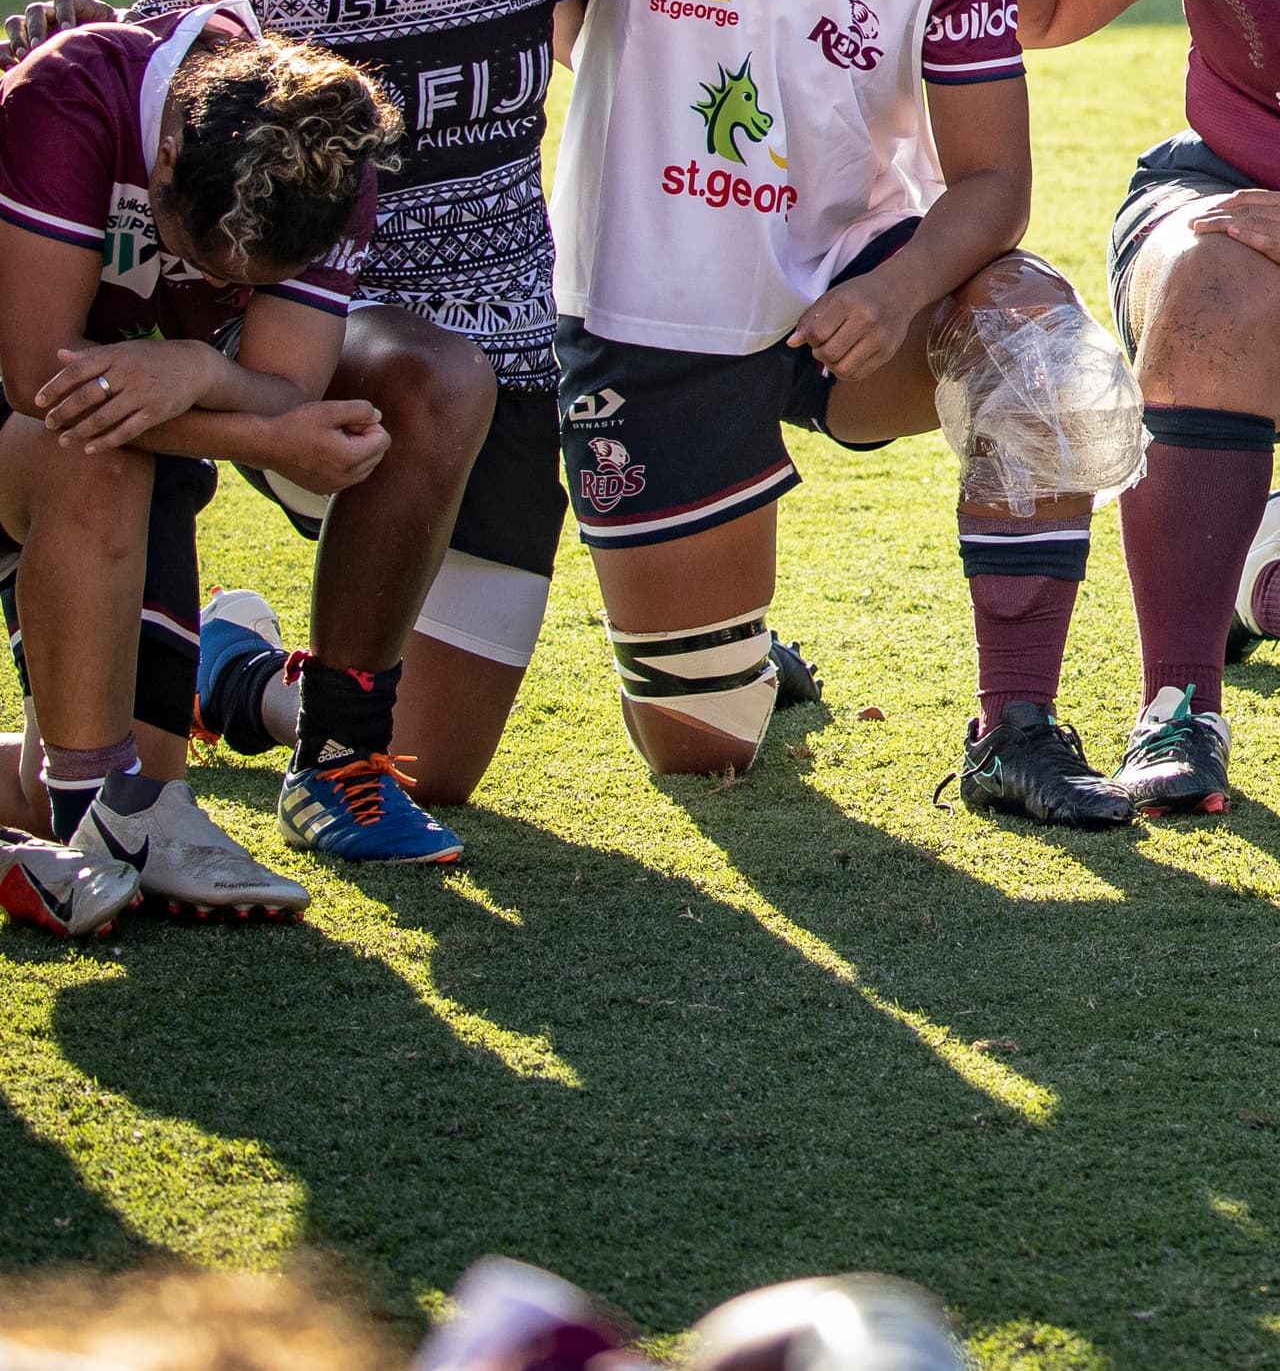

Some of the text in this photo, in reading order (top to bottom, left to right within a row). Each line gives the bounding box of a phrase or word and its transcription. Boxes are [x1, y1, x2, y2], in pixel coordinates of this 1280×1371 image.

[807, 16, 884, 72] REDS
[416, 41, 549, 131] FIJI
[106, 214, 158, 241] SUPE
[572, 418, 625, 430] DYNASTY
[580, 465, 646, 513] REDS
[317, 747, 355, 764] adidas
